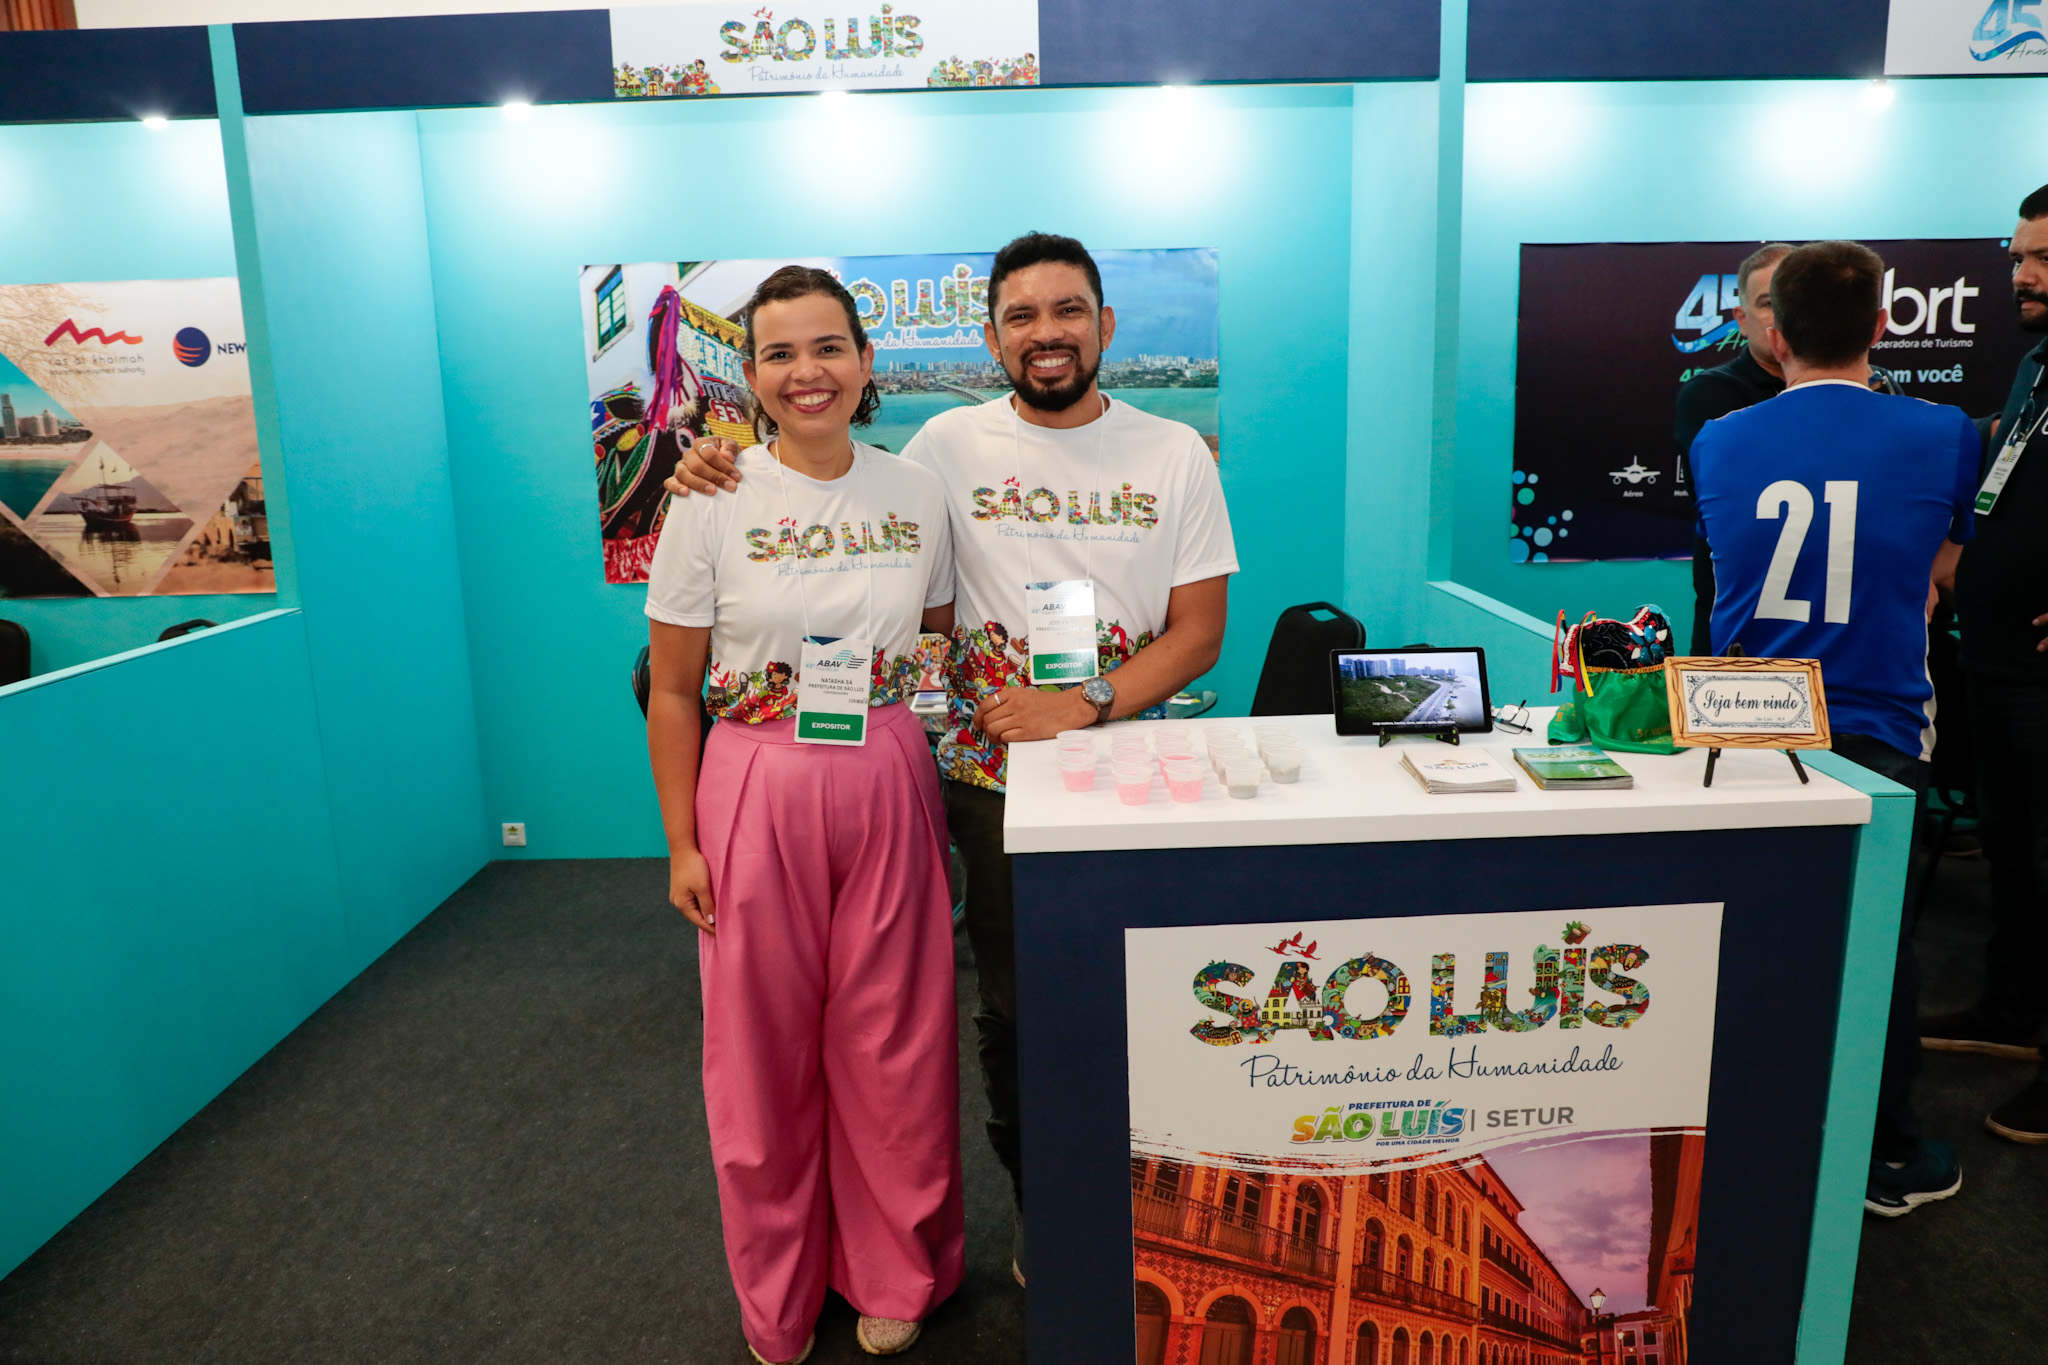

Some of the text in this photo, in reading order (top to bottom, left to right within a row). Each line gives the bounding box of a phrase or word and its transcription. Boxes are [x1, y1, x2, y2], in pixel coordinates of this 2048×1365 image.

[1972, 0, 2043, 45] 45
[720, 6, 816, 63] SÃO
[748, 63, 904, 82] Patrimônio da Humanidade
[1882, 267, 1979, 335] brt
[884, 332, 899, 347] da
[902, 329, 981, 347] Humanidade
[1921, 339, 1933, 348] de
[1935, 338, 1973, 348] Turismo
[217, 343, 247, 355] NEW
[1917, 363, 1963, 383] você
[970, 475, 1061, 523] SÃO
[745, 516, 835, 562] SÃO
[1056, 529, 1072, 540] da
[1073, 527, 1141, 543] Humanidade
[1754, 480, 1858, 624] 21
[835, 560, 851, 573] da
[852, 557, 912, 571] Humanidade
[817, 659, 843, 668] ABAV
[1045, 662, 1083, 670] EXPOSITOR
[1703, 689, 1799, 717] Seja bem vindo
[812, 722, 851, 730] EXPOSITOR
[1190, 930, 1411, 1046] SÃO
[1240, 1044, 1623, 1088] Patrimônio da Humanidade
[1348, 1099, 1431, 1110] PREFEITURA DE
[1291, 1101, 1574, 1143] SÃO LUÍS SETUR
